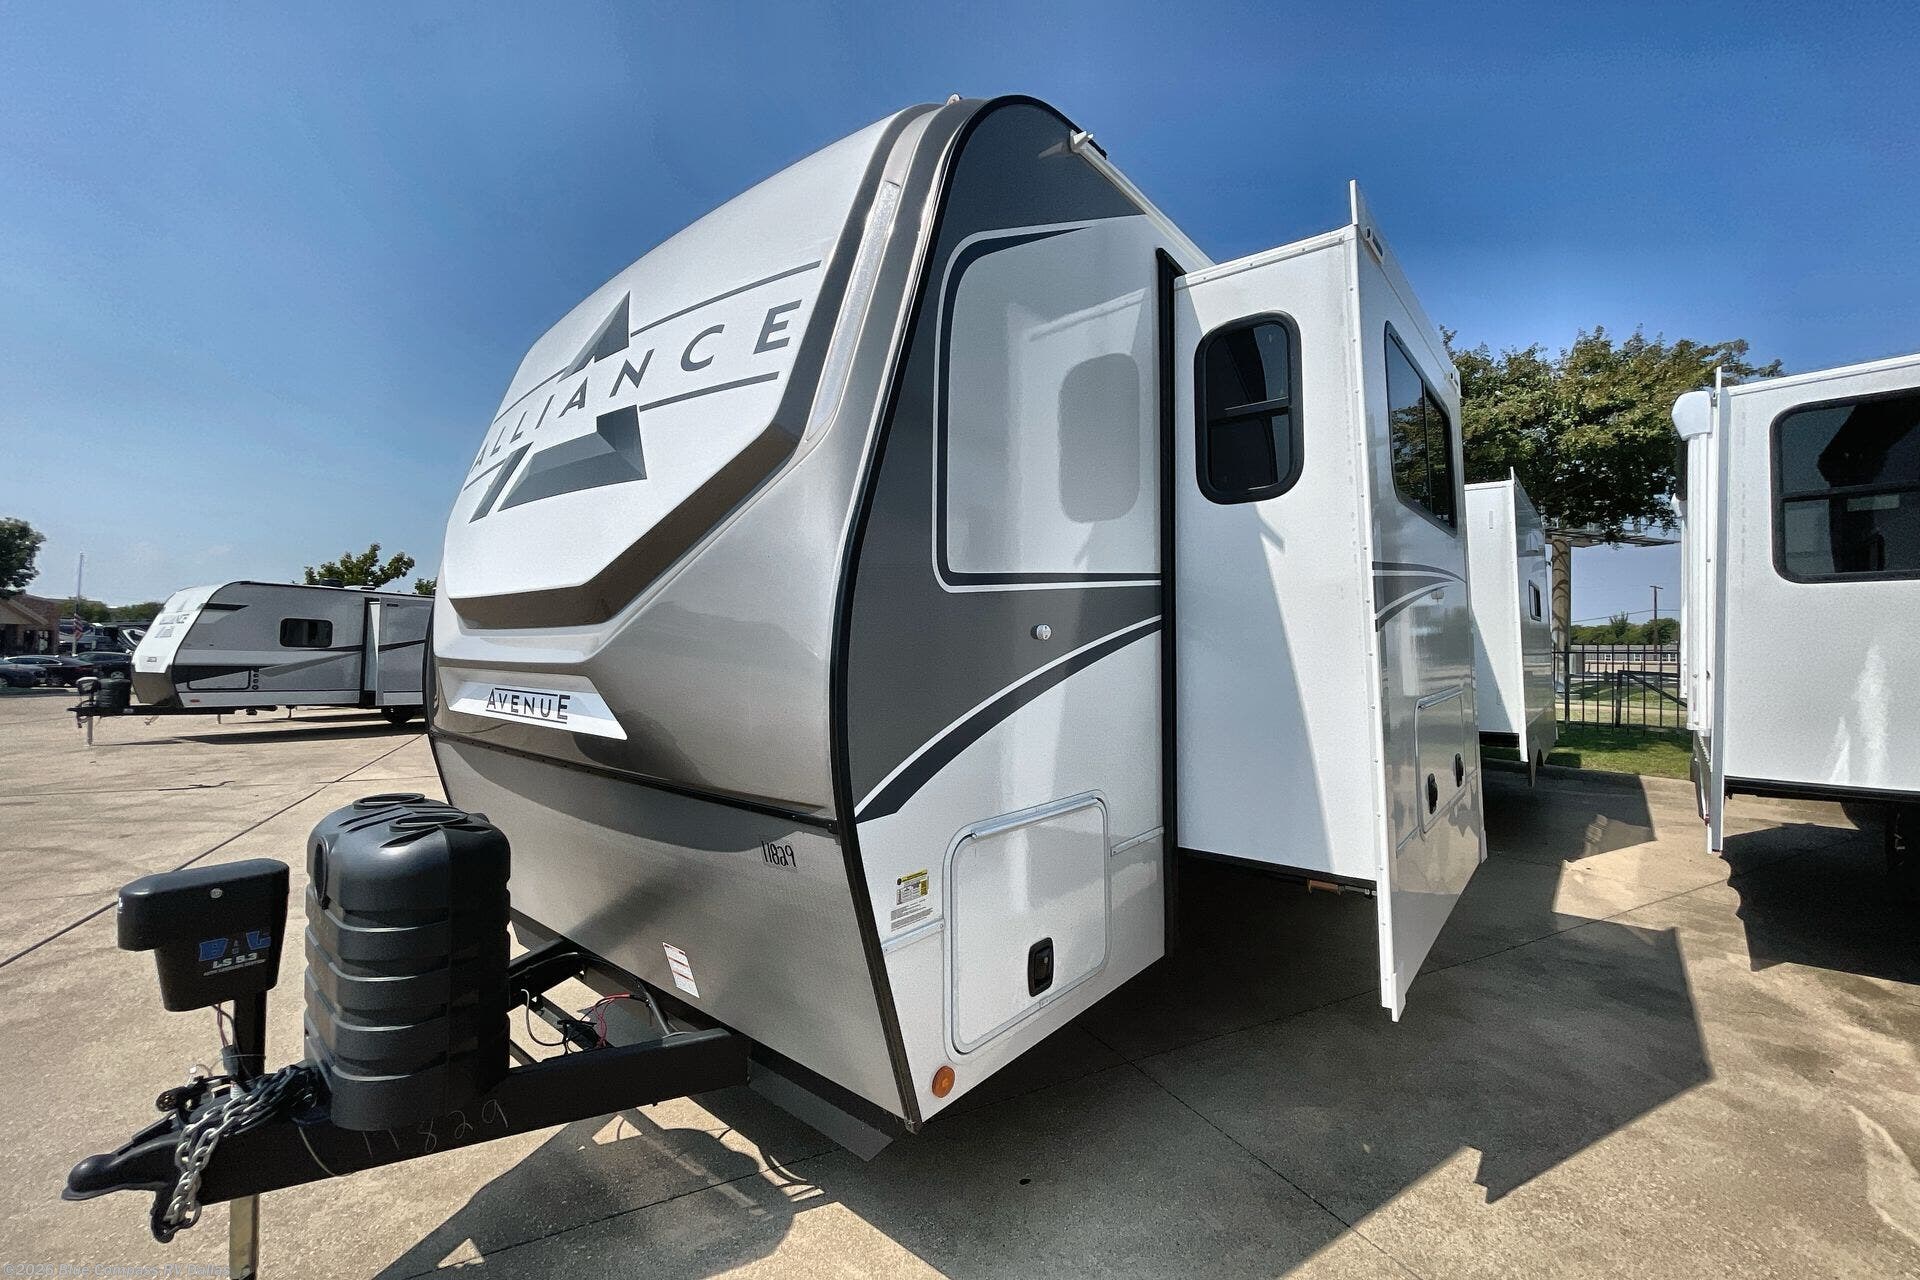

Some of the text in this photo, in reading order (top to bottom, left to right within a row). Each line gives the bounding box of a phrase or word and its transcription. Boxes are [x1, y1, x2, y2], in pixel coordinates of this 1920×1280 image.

[470, 299, 802, 473] ALLIANCE
[486, 688, 571, 721] AVENUE
[761, 840, 796, 867] 11829
